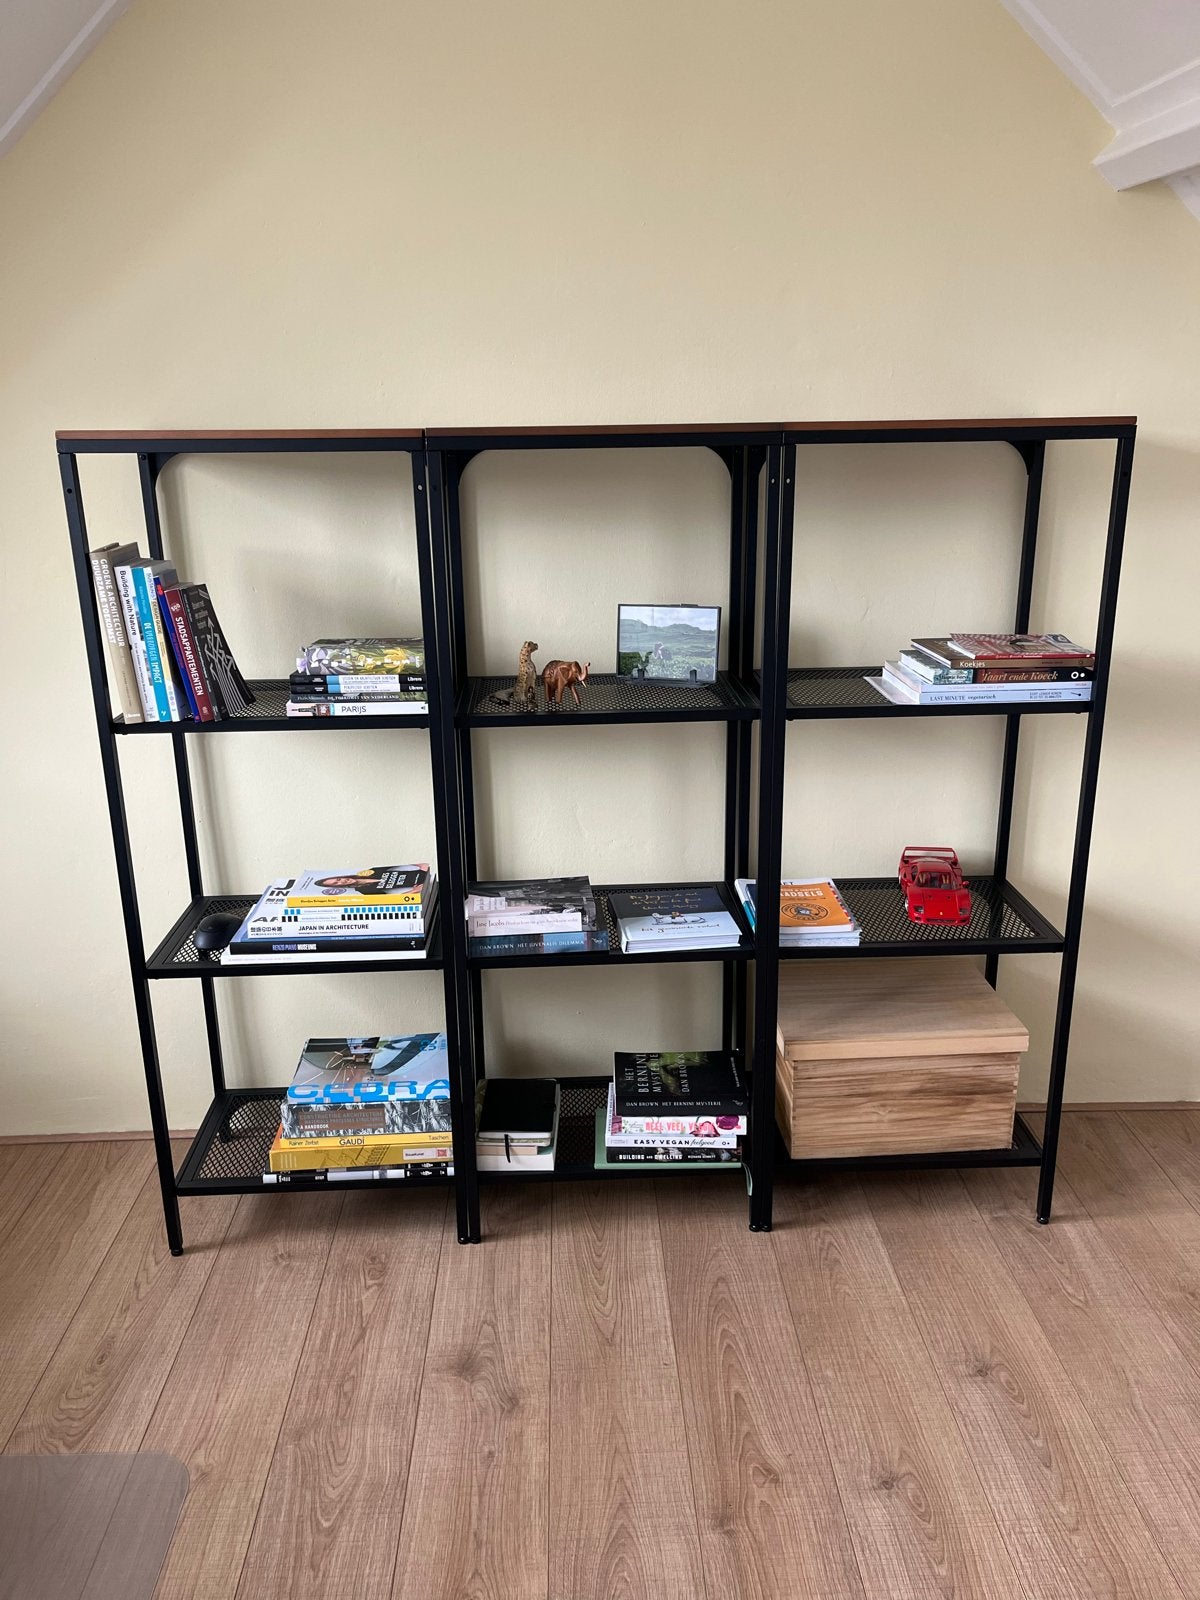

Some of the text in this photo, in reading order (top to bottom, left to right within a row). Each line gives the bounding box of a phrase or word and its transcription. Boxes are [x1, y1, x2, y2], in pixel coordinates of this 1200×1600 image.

[91, 559, 117, 644] DUURZAME TOEKOMST
[100, 558, 126, 648] GROENE ARCHITECTUUR
[119, 570, 138, 636] Building with Nature
[144, 622, 153, 630] DE
[151, 661, 163, 684] IMPACT
[175, 617, 205, 696] STADSAPPARTEMENTEN
[959, 661, 986, 669] Koekjes
[341, 704, 367, 715] PARIJS
[325, 922, 369, 931] ARCHITECTURE
[625, 1067, 635, 1081] HET
[636, 1054, 650, 1093] BERNINI
[650, 1053, 662, 1093] MYSTERIE
[678, 1053, 690, 1093] DAN BROWN
